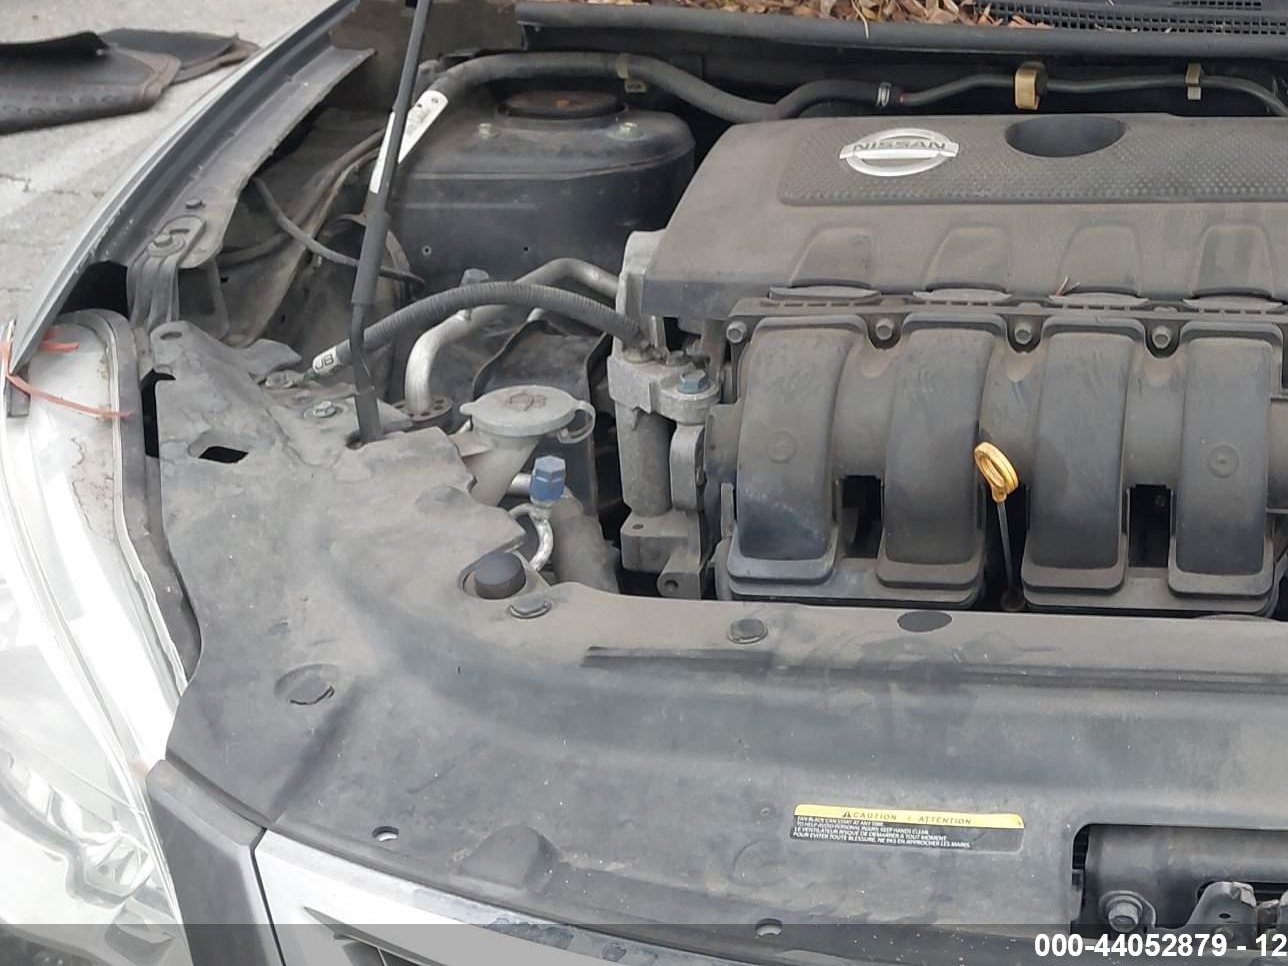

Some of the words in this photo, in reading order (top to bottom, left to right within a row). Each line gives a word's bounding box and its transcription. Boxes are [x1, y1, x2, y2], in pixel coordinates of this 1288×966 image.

[853, 140, 946, 151] NISSAN
[852, 811, 897, 820] CAUTION
[918, 815, 972, 825] ATTENTION
